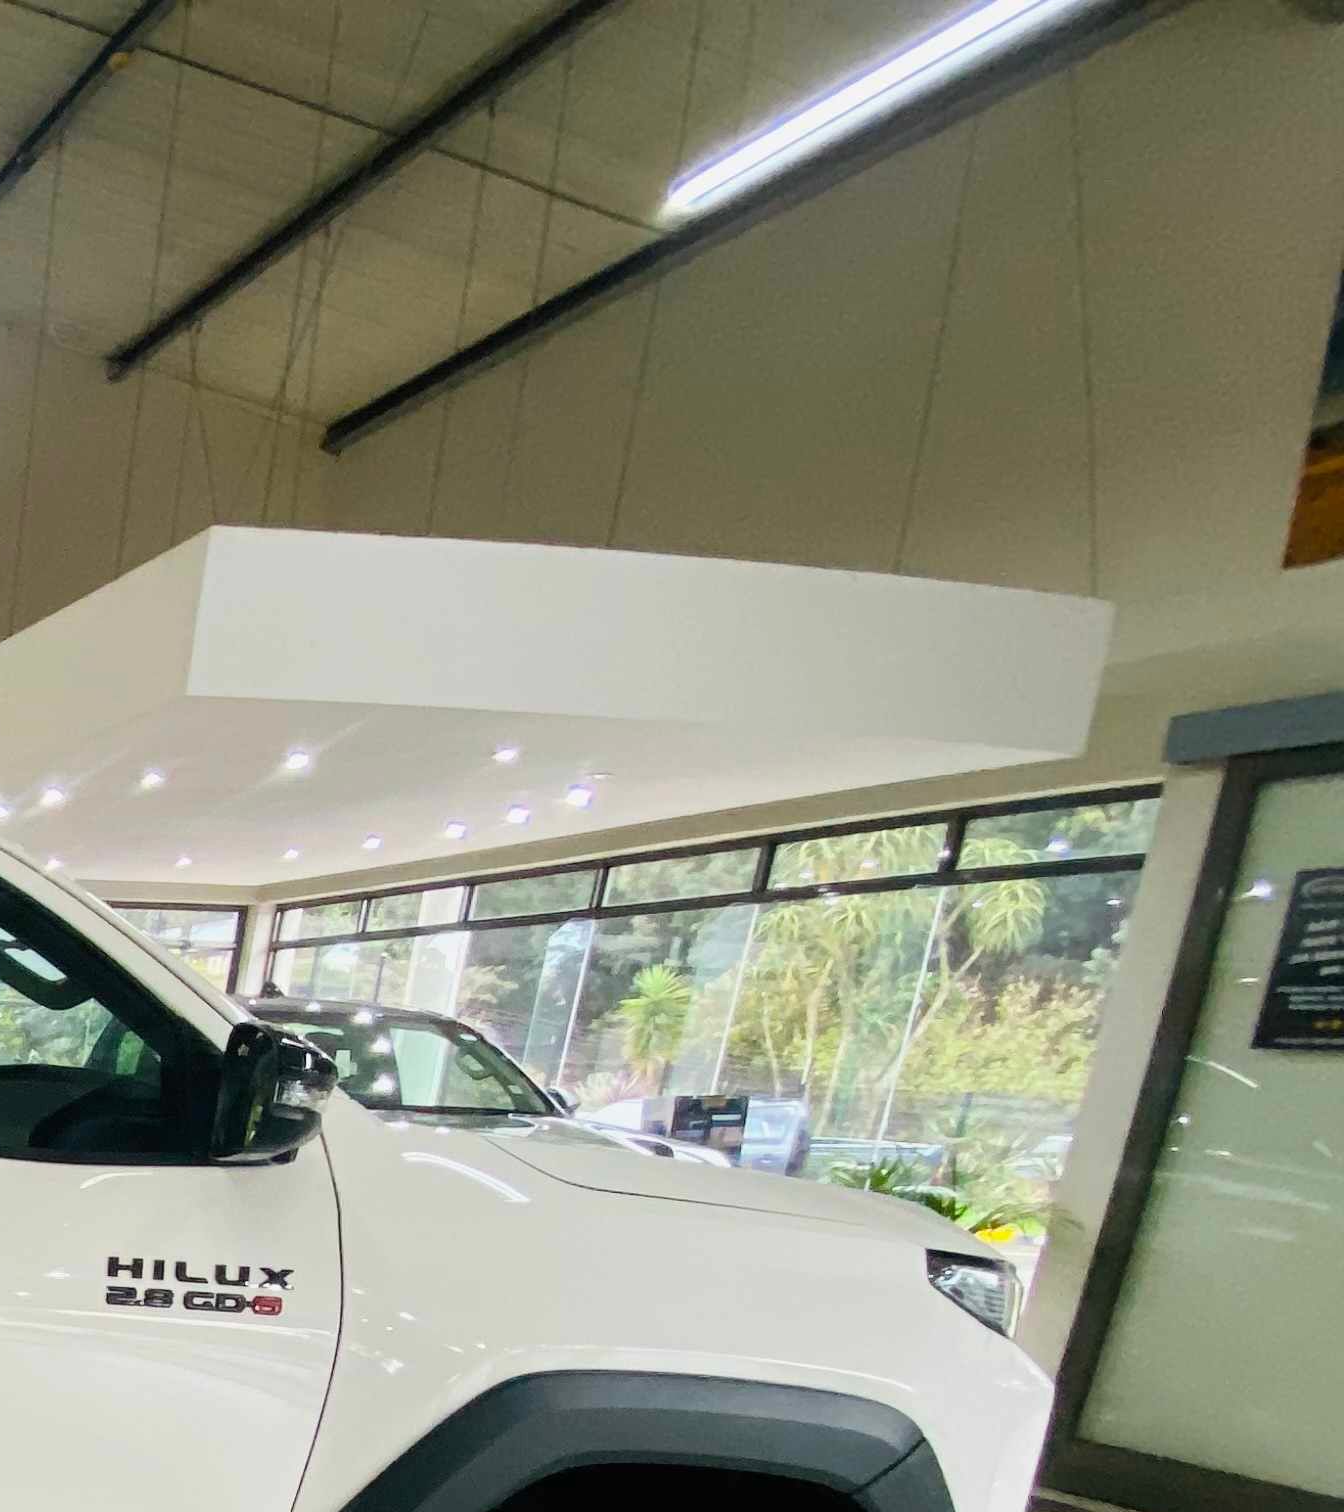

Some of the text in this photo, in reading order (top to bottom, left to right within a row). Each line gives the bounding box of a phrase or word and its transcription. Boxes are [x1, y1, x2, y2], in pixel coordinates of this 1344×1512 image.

[107, 1256, 295, 1290] HILUX
[105, 1286, 283, 1316] 2.8 GD-6
